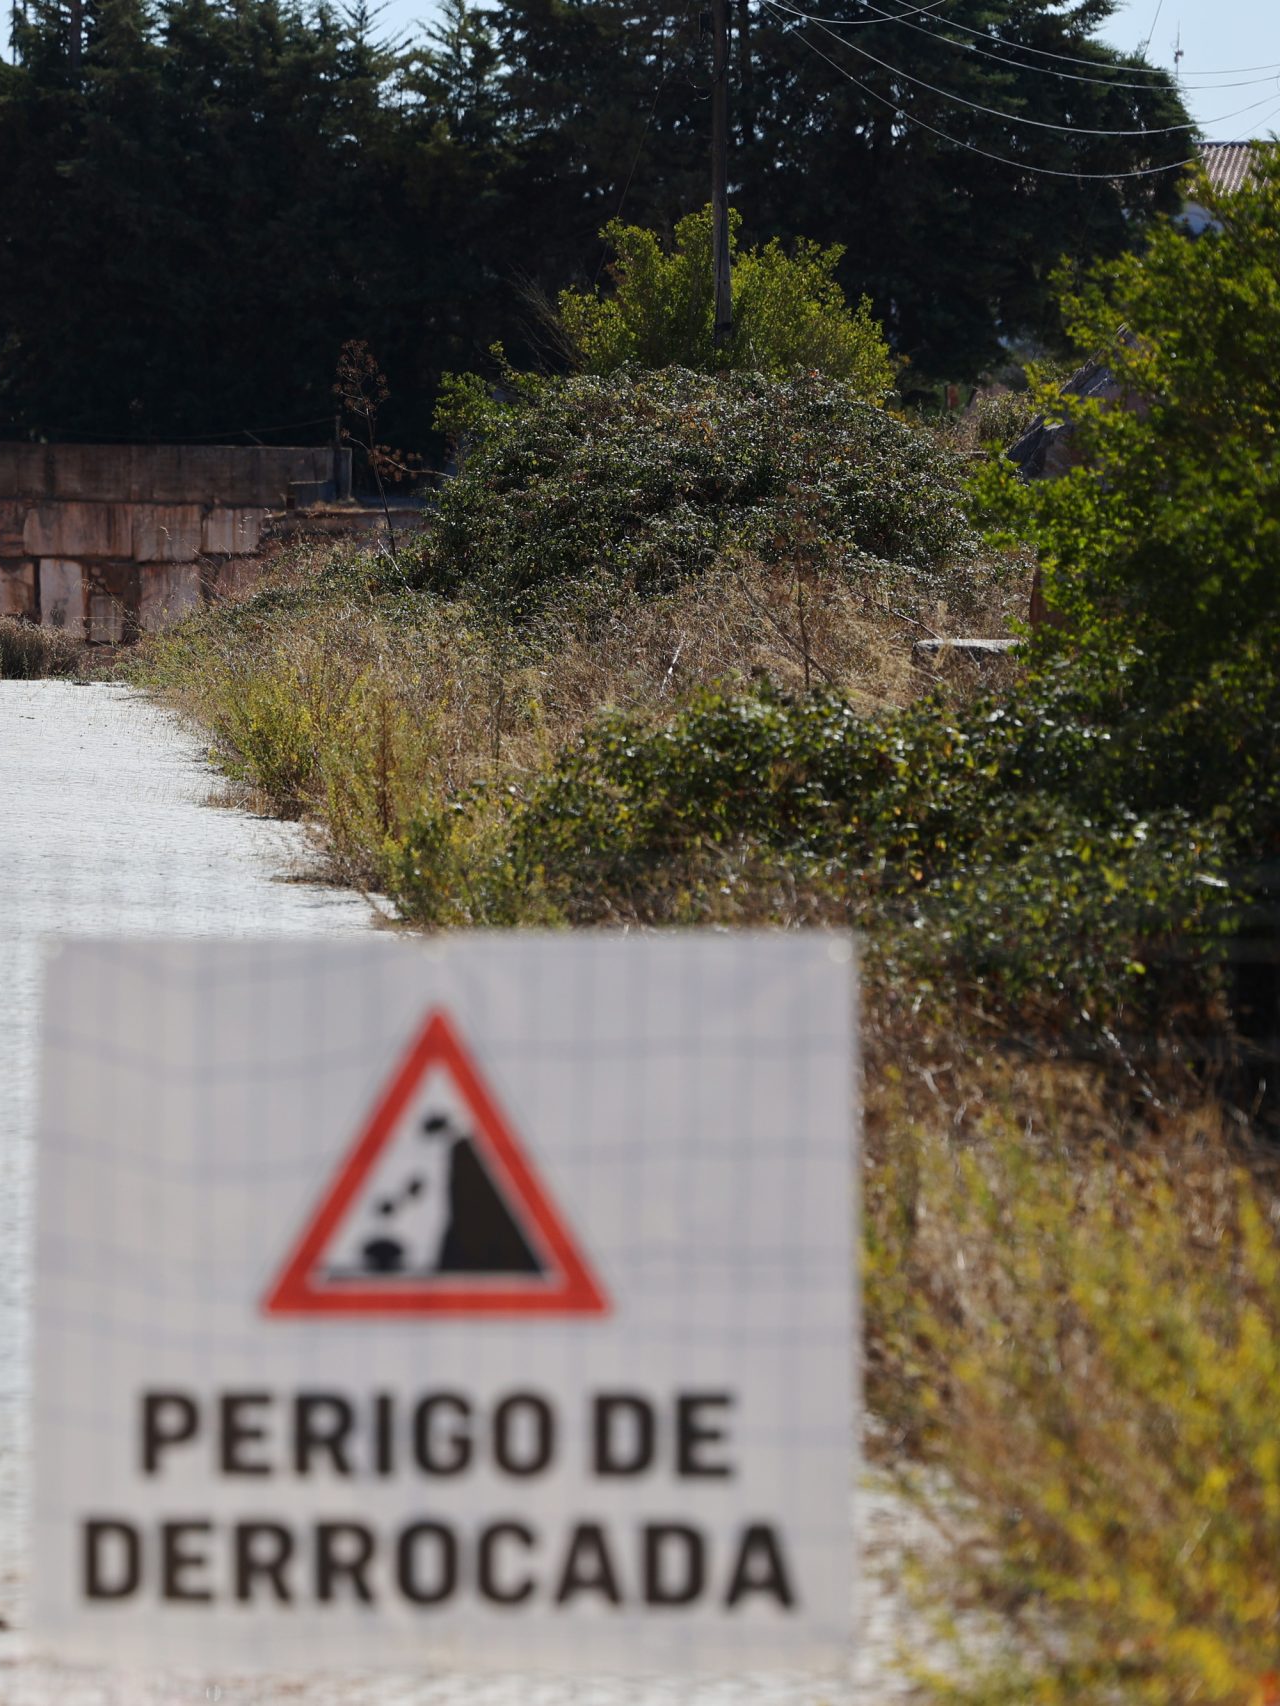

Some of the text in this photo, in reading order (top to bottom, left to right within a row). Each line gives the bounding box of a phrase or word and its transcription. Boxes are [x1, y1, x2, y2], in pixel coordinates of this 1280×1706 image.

[141, 1391, 733, 1480] PERIGO DE
[82, 1518, 797, 1610] DERROCADA
